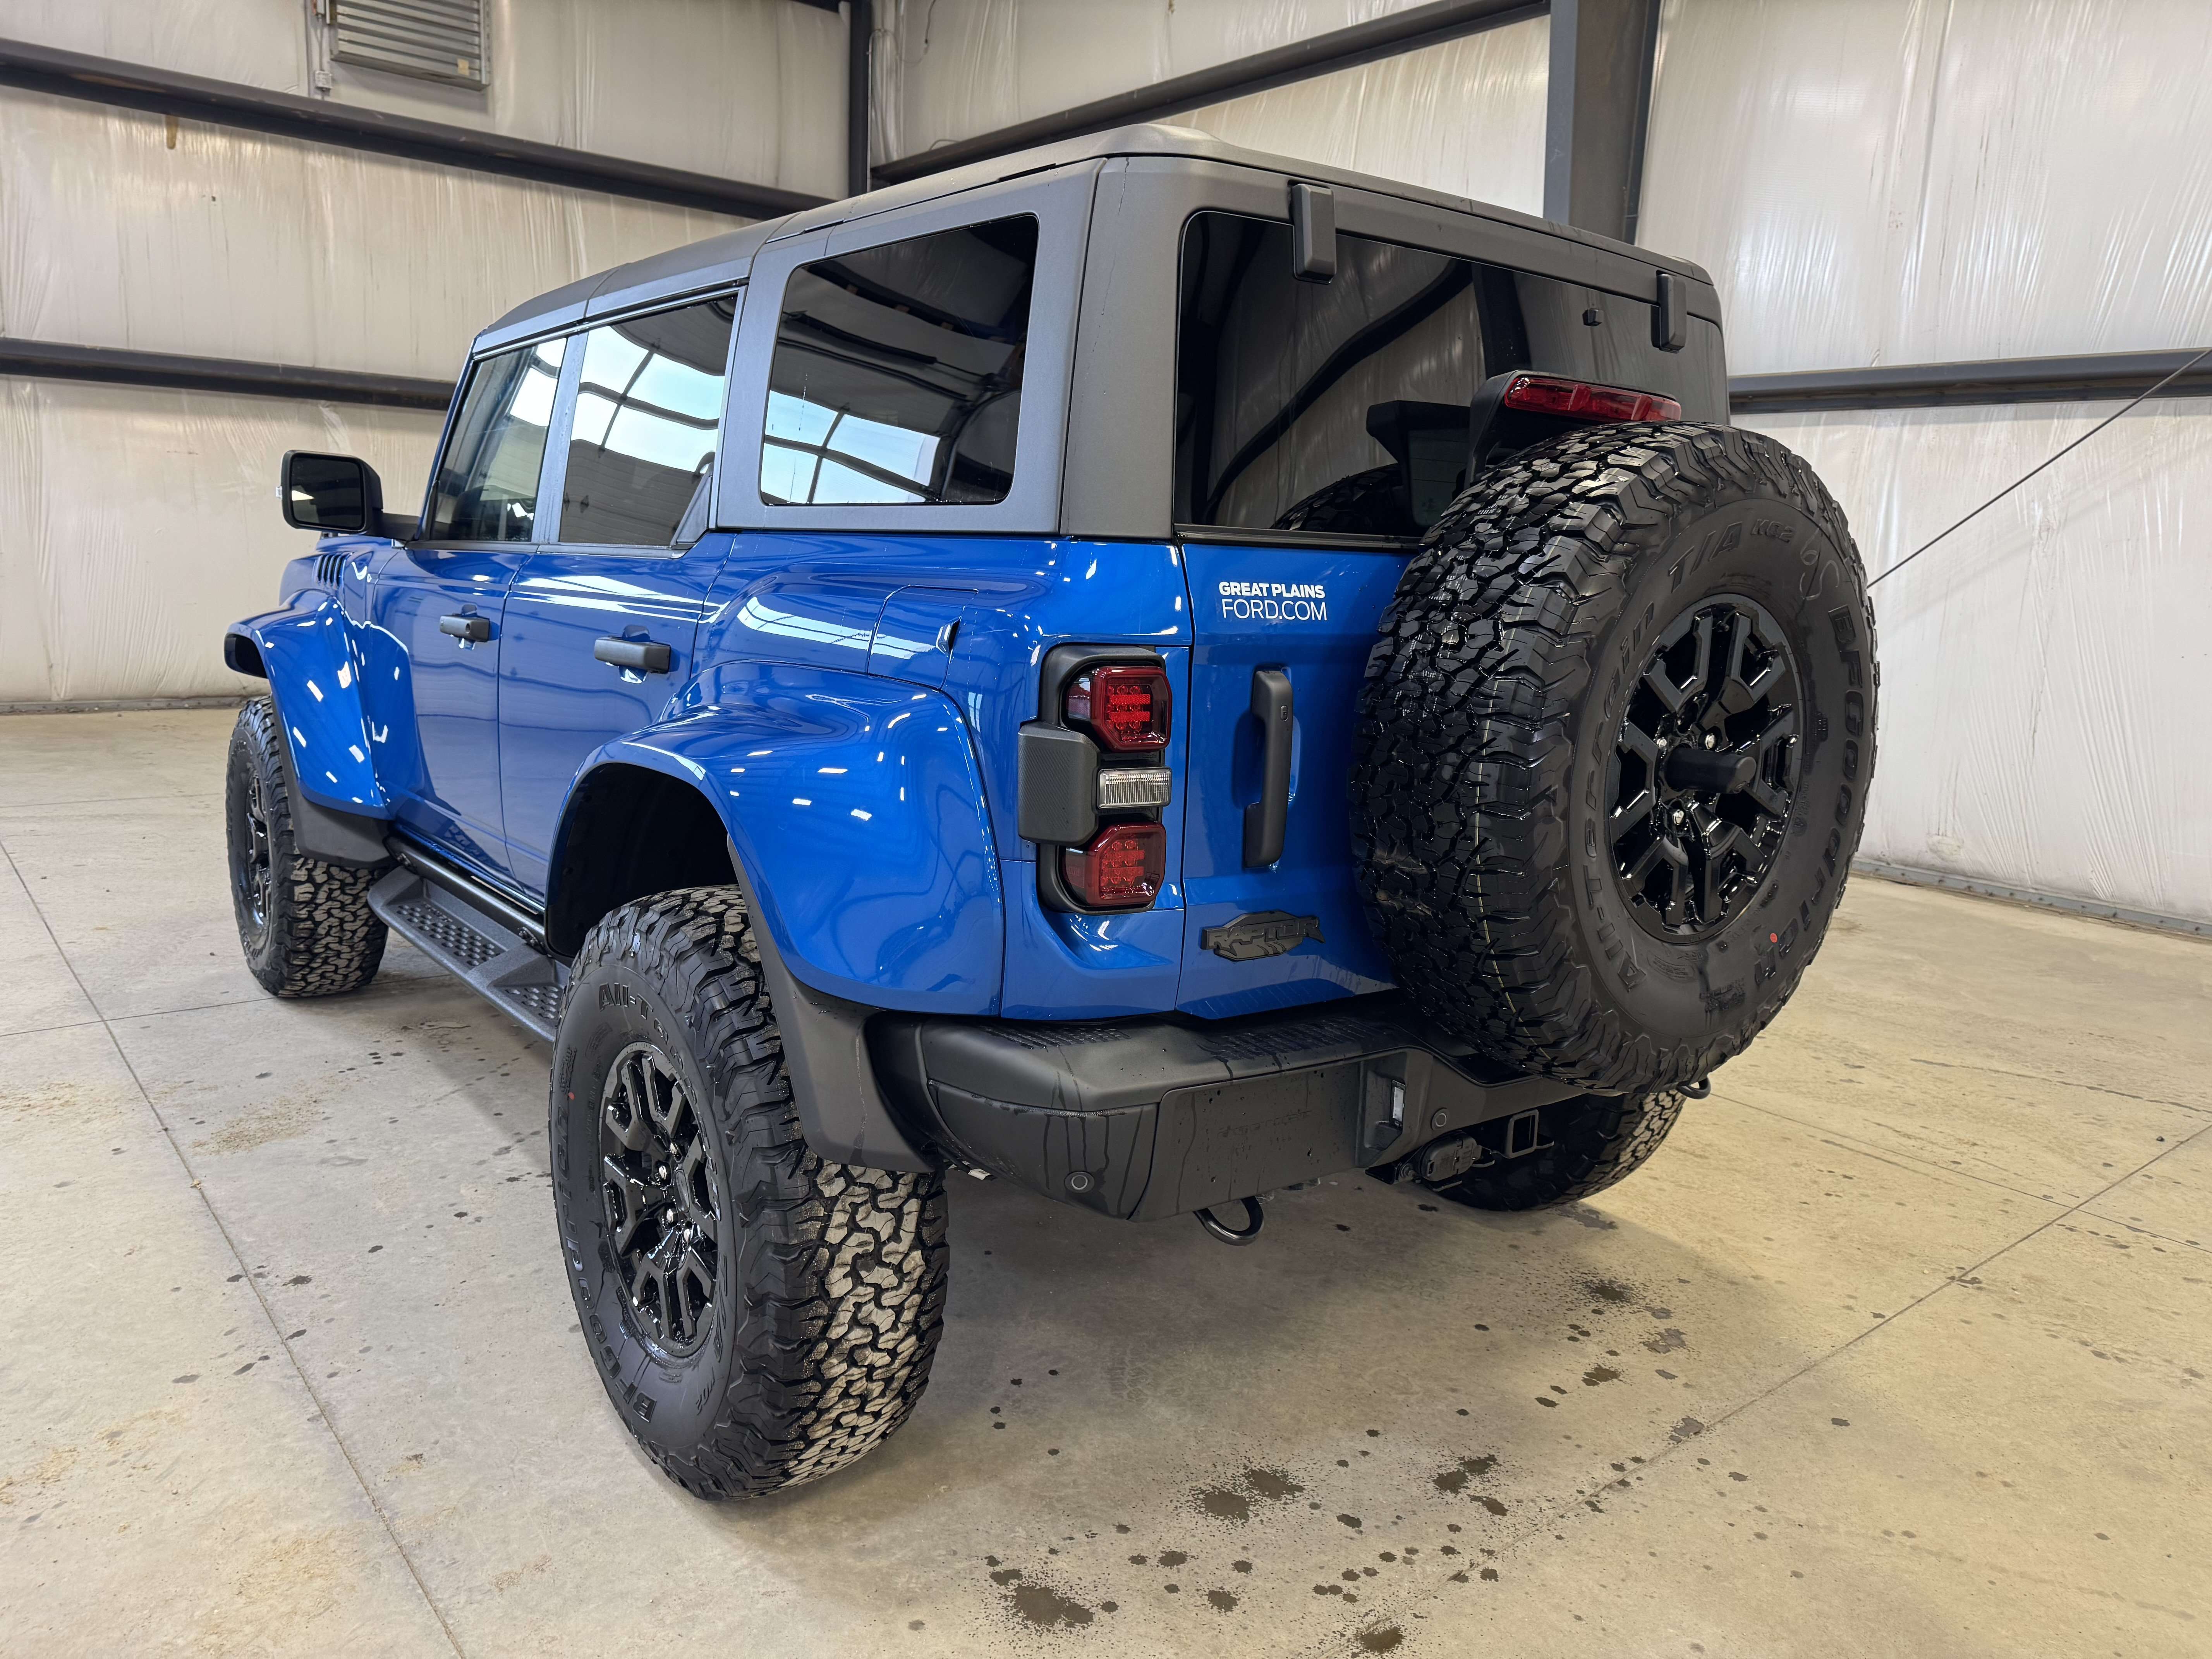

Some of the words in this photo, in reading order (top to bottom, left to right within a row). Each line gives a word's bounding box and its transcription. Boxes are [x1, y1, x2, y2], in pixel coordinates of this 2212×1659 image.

[1667, 520, 1743, 594] T/A
[1750, 518, 1796, 544] KO2
[1219, 582, 1269, 596] GREAT
[1272, 584, 1325, 598] PLAINS
[1222, 599, 1327, 621] FORD.COM
[1583, 600, 1655, 993] All-Terrain
[1753, 603, 1864, 987] BFGoodrich
[1208, 918, 1325, 956] RAPTOR
